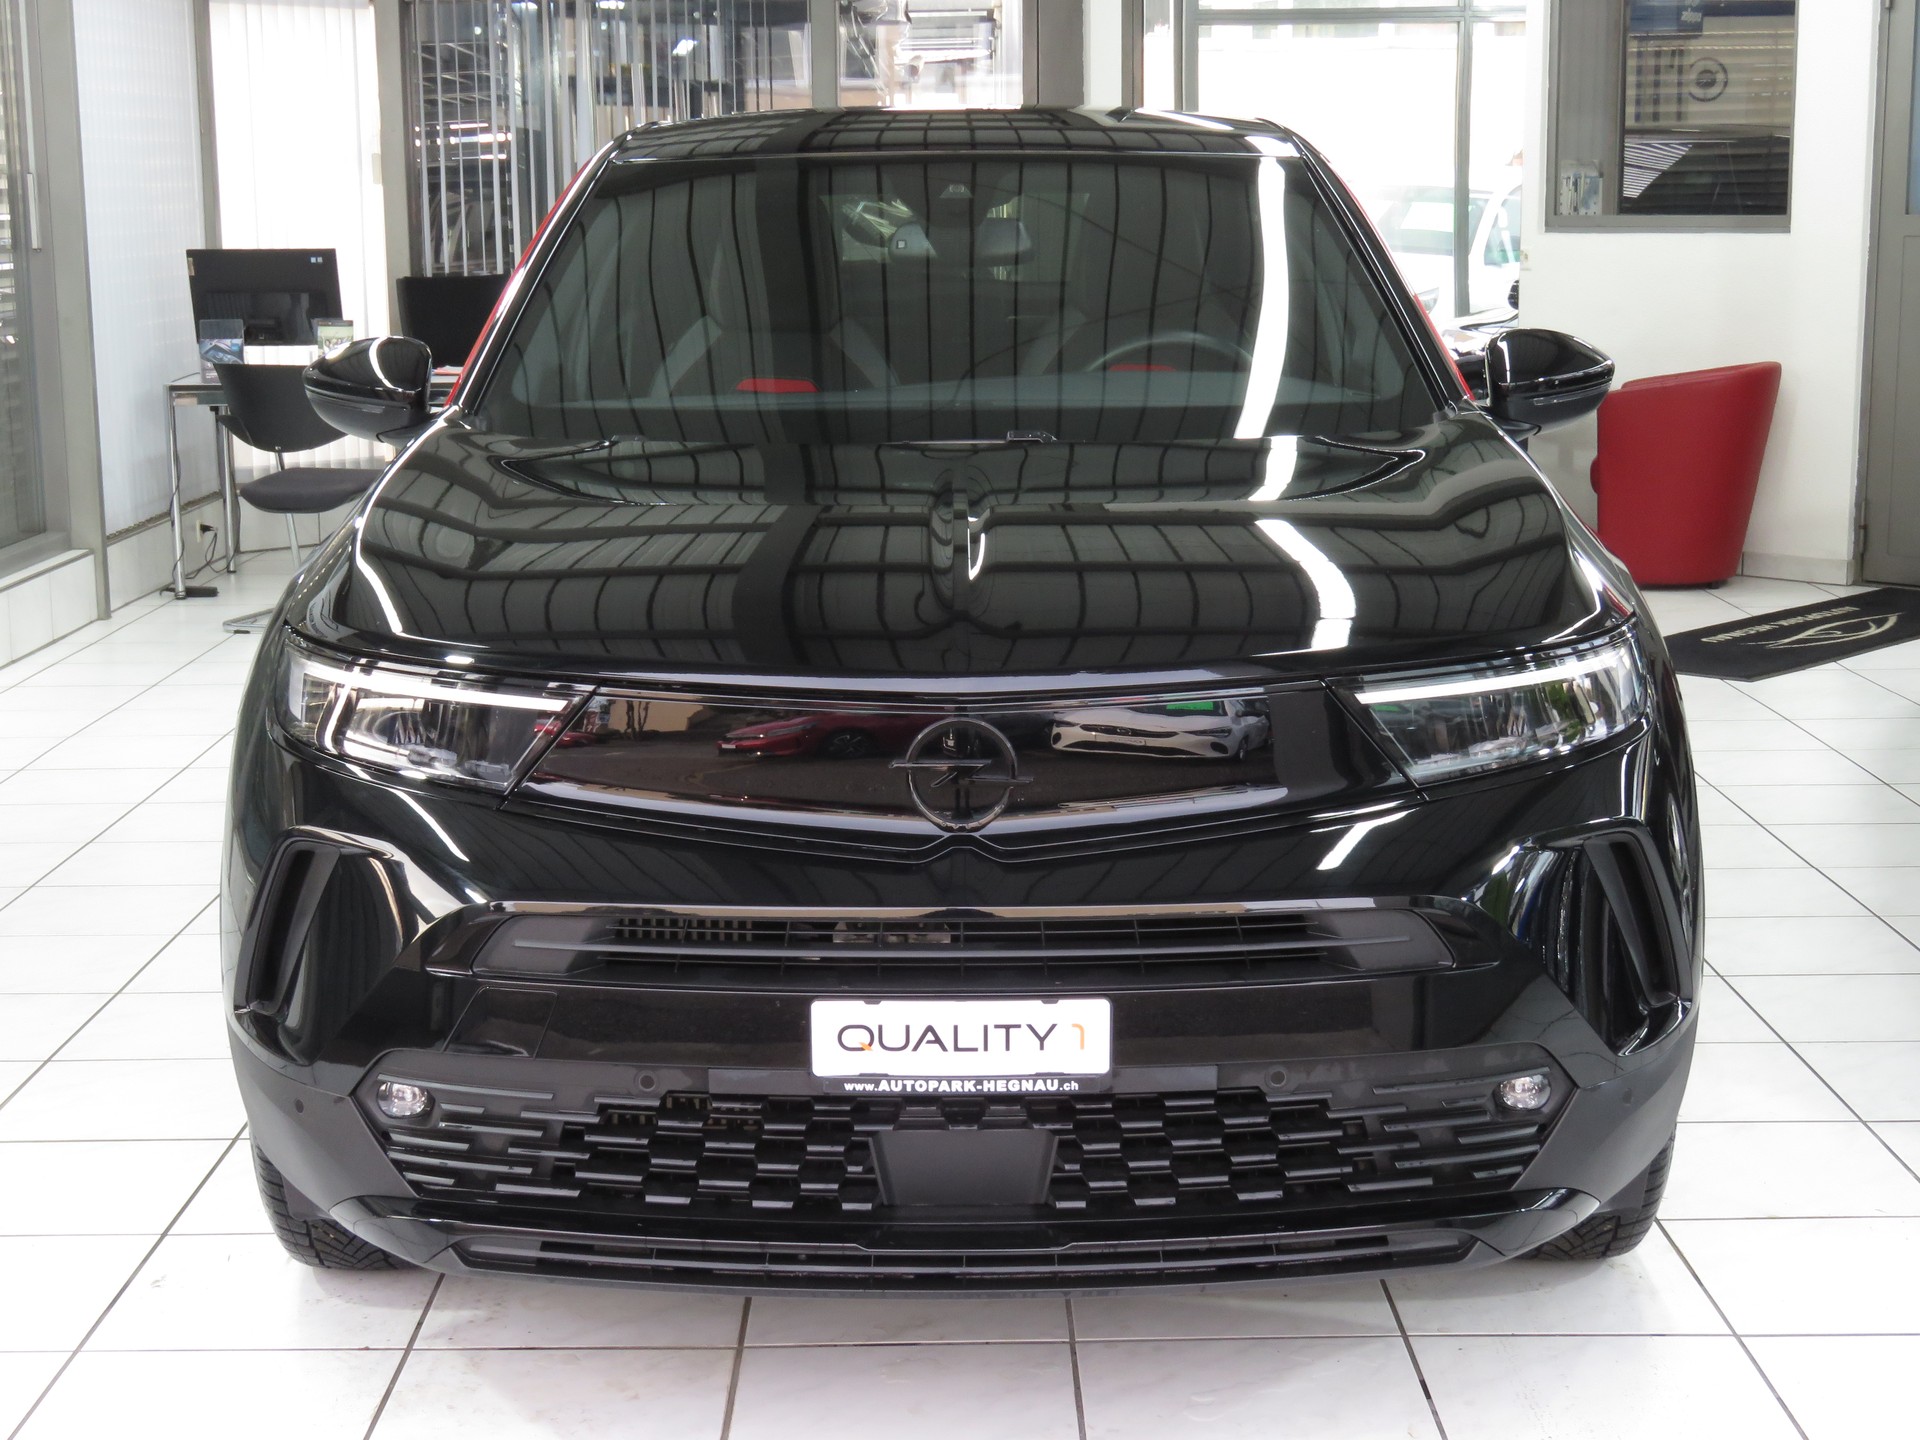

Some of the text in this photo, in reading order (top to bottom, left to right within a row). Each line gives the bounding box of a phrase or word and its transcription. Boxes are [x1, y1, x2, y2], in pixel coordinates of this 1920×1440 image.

[837, 1023, 1085, 1052] QUALITY 1
[843, 1079, 1079, 1093] www.AUTOPARK-HEGNAU.ch
